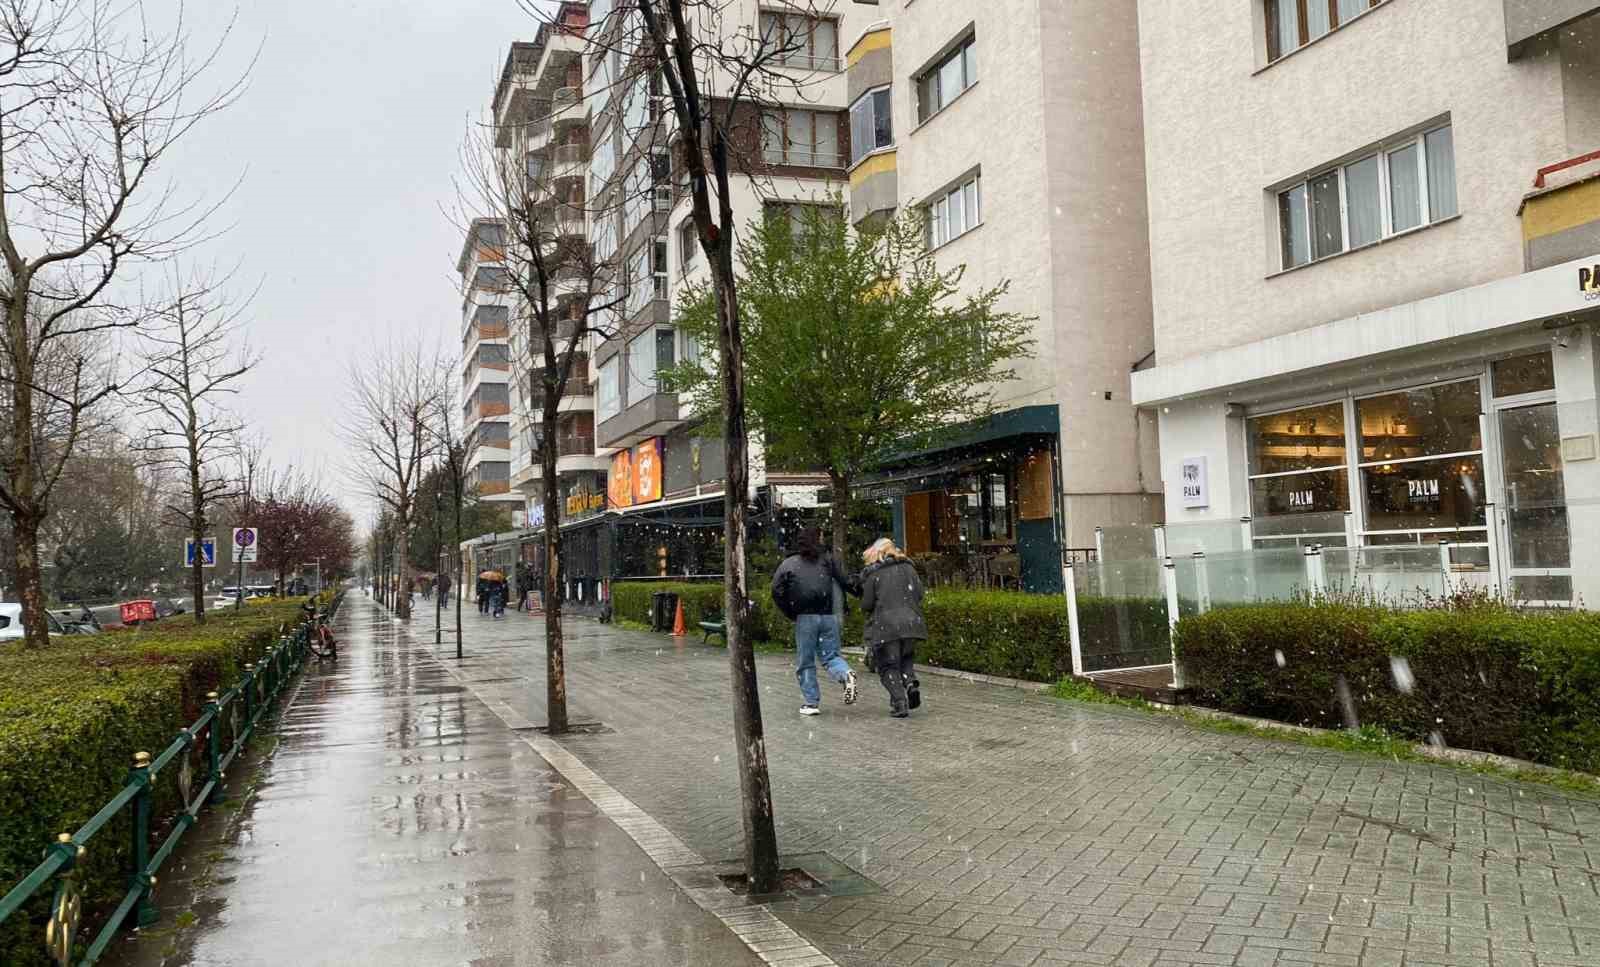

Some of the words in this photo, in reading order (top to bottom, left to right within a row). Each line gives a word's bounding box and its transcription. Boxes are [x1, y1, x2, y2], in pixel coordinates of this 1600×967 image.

[1184, 485, 1200, 496] PALM
[1408, 480, 1439, 496] PALM
[1289, 490, 1313, 505] PALM
